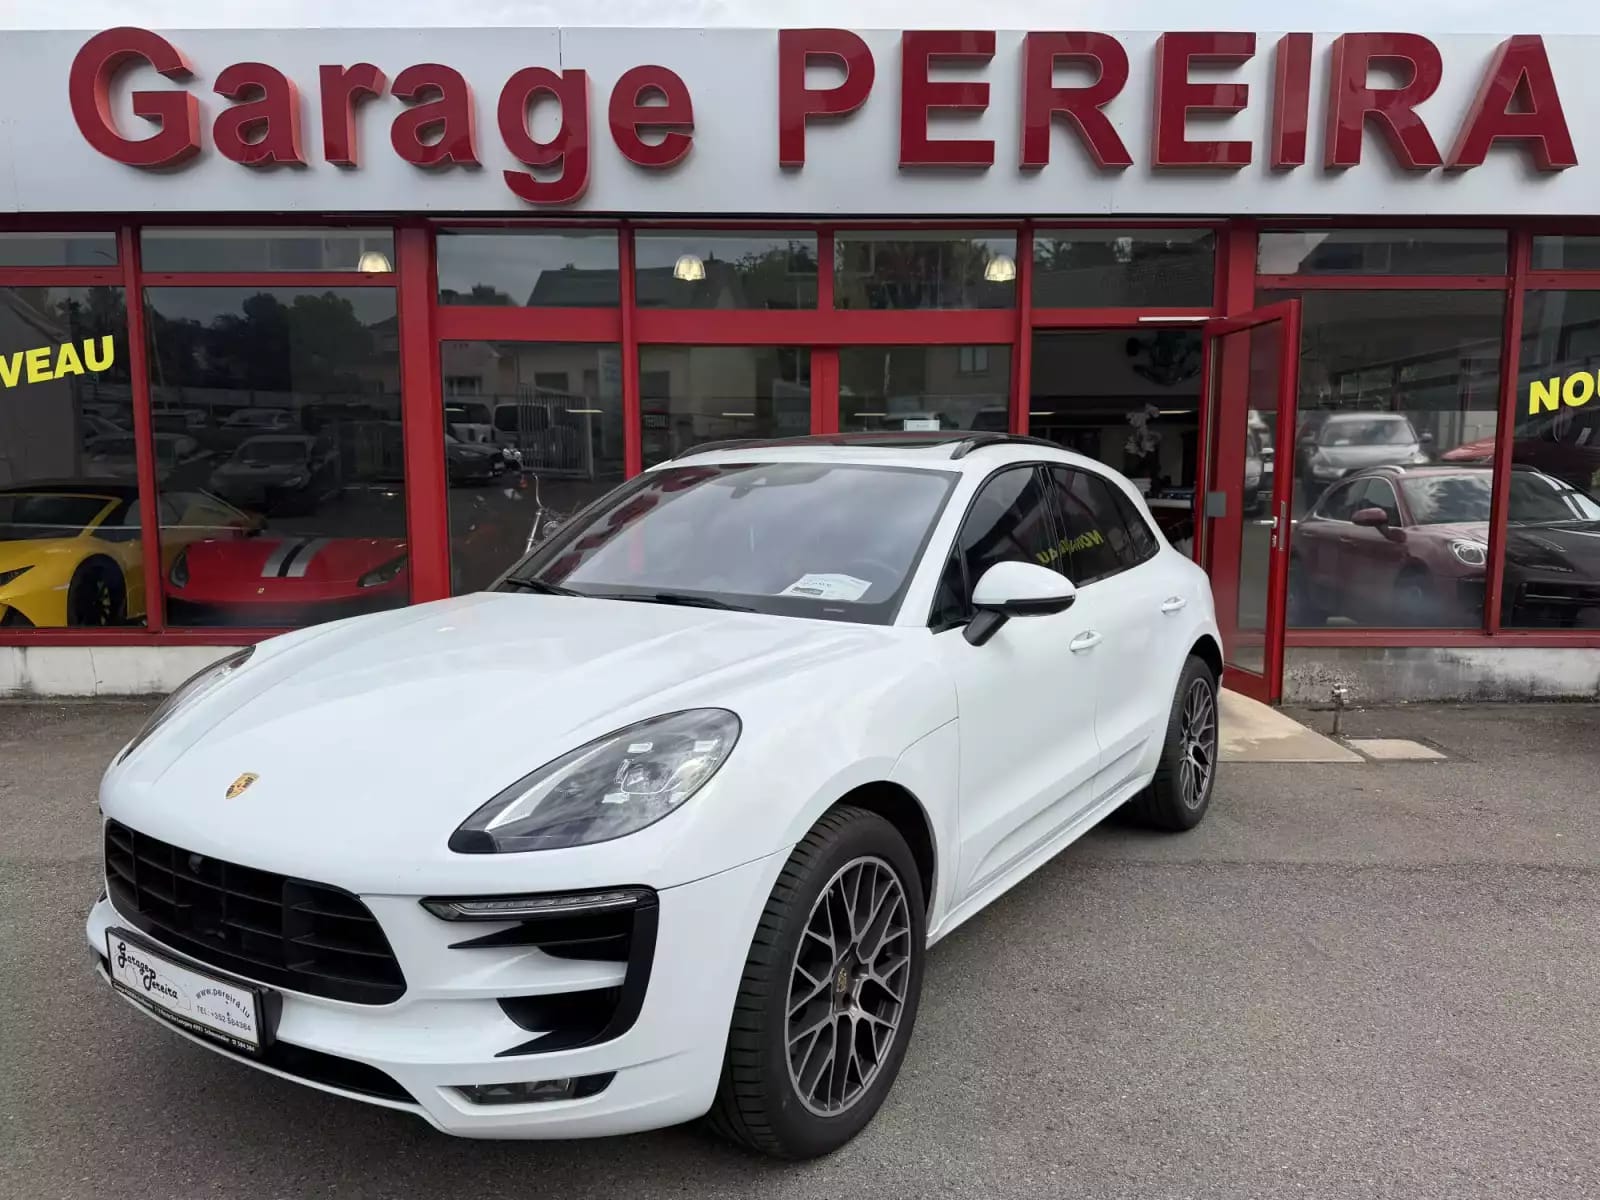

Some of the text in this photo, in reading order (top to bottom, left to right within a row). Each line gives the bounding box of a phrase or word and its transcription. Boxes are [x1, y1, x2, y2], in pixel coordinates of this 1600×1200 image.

[69, 26, 1579, 204] Garage PEREIRA
[0, 335, 115, 388] VEAU
[1528, 368, 1600, 416] NO
[117, 942, 150, 975] Garage
[143, 968, 178, 999] Pereira
[195, 988, 250, 1018] www.pereira.lu
